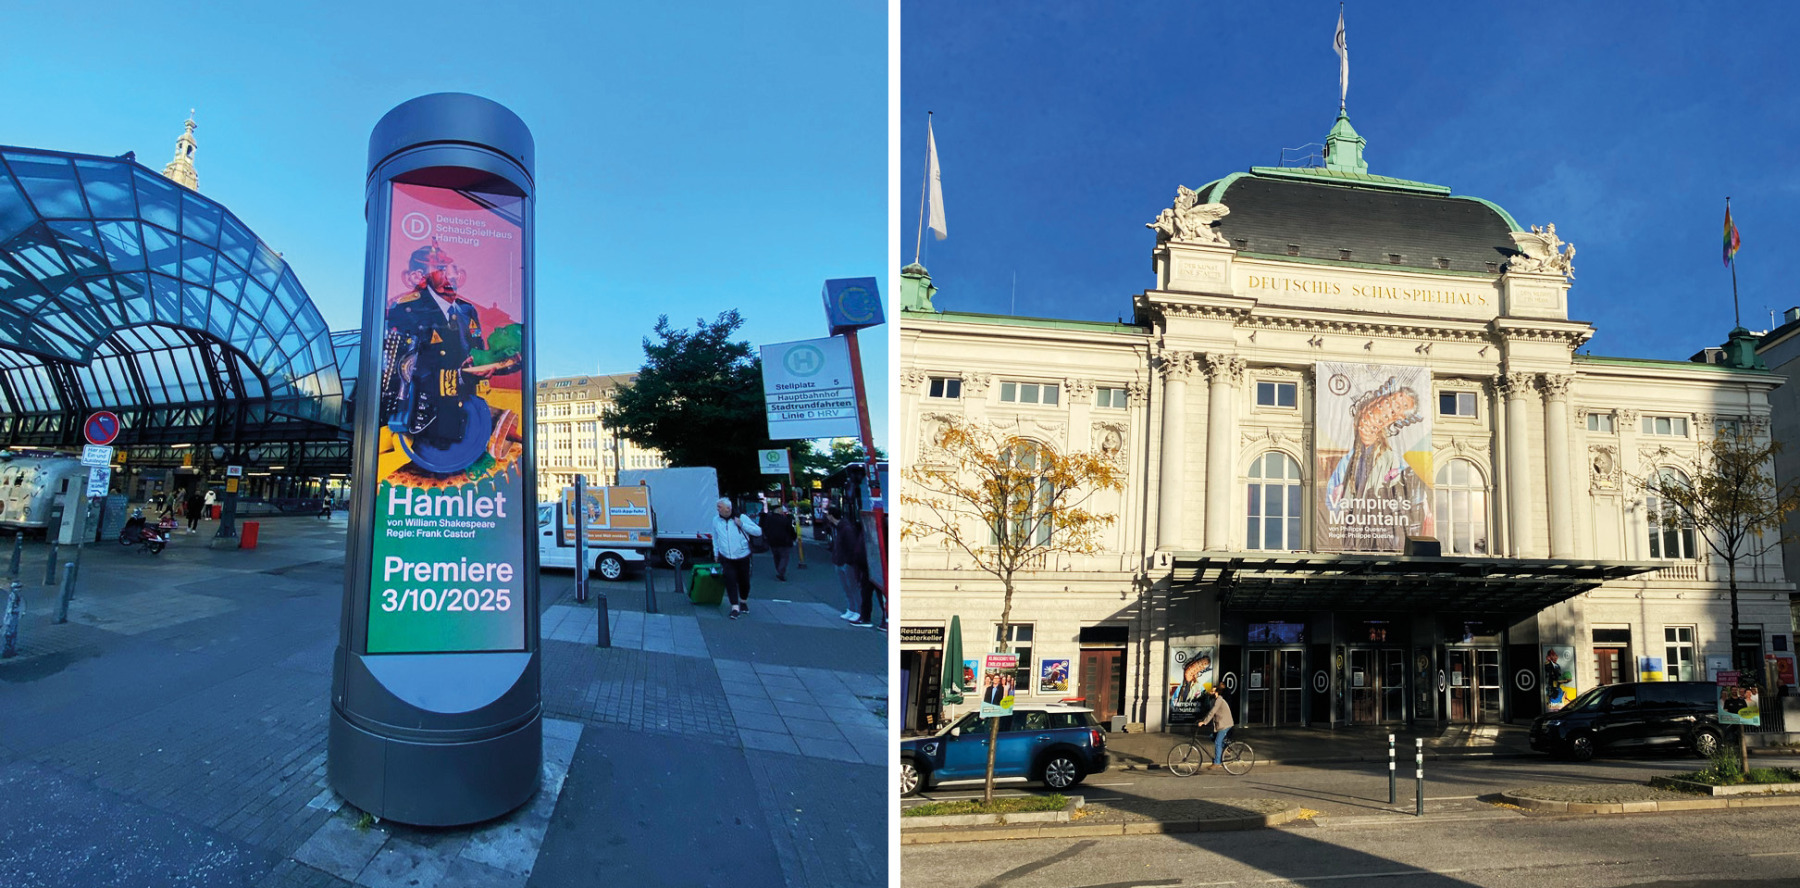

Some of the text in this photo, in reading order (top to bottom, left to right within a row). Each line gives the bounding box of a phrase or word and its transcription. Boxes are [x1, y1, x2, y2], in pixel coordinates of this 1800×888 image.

[436, 214, 486, 227] Deutsches
[436, 224, 513, 239] SchauSpielHaus
[436, 233, 480, 247] Hamburg
[1249, 275, 1490, 307] DEUTSCHES SCHAUSPIELHAUS.
[775, 381, 816, 391] Stellplatz
[777, 390, 840, 402] Hauptbahnhof
[771, 400, 852, 411] Stadtrundfahrten
[781, 411, 805, 420] Linie
[817, 409, 839, 417] HRV
[387, 487, 507, 518] Hamlet
[1328, 494, 1412, 513] Vampire's
[387, 518, 496, 529] von William Shakespeare
[1329, 510, 1409, 526] Mountain
[386, 528, 476, 538] Regie: Frank Castorf
[384, 556, 513, 582] Premiere
[381, 588, 512, 612] 3/10/2025
[901, 627, 939, 635] Restaurant
